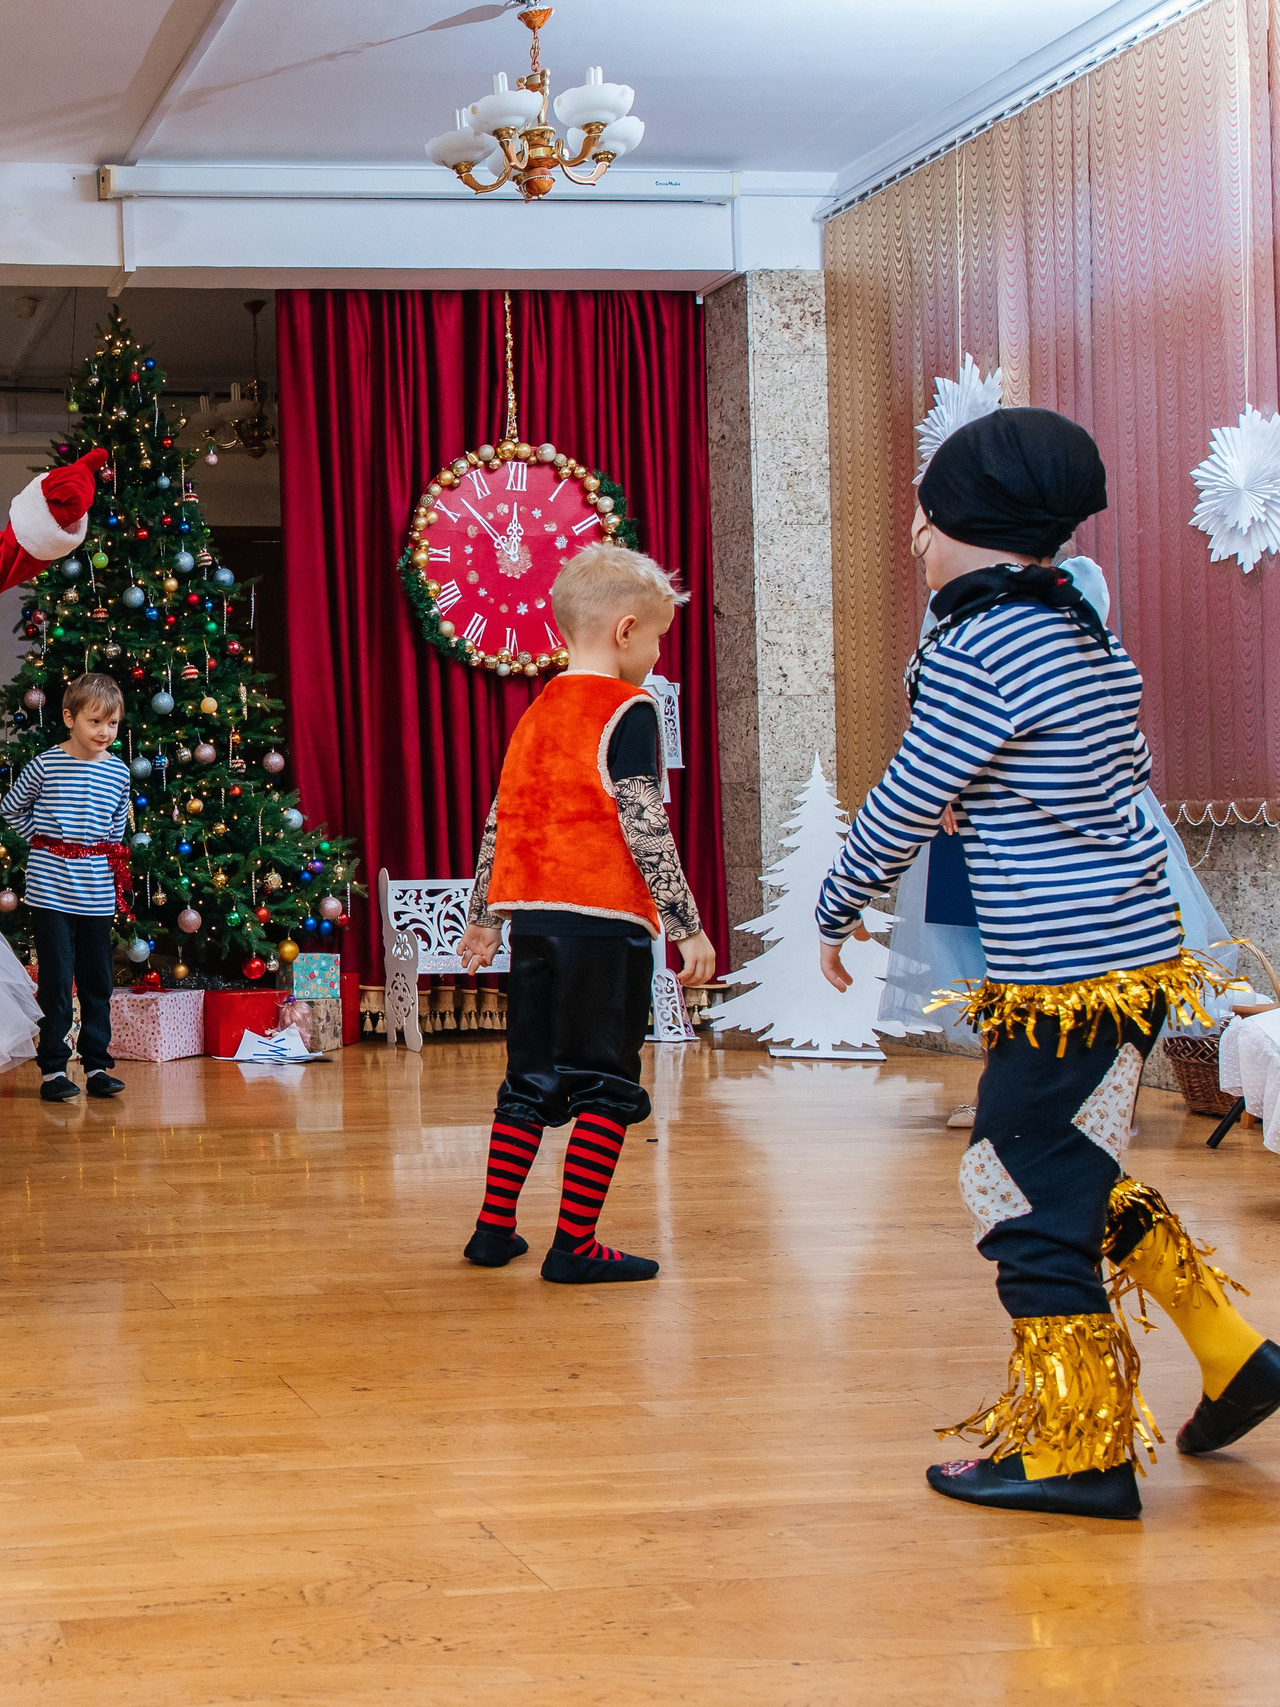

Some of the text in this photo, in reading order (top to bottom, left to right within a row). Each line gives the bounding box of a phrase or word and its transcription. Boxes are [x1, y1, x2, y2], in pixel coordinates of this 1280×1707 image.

[466, 468, 492, 500] XI
[505, 461, 527, 492] XII
[434, 499, 461, 523] X
[571, 512, 602, 536] II
[428, 546, 451, 563] IX
[435, 579, 463, 616] VIII
[462, 612, 488, 647] VII
[505, 627, 520, 657] VI
[544, 621, 562, 650] V
